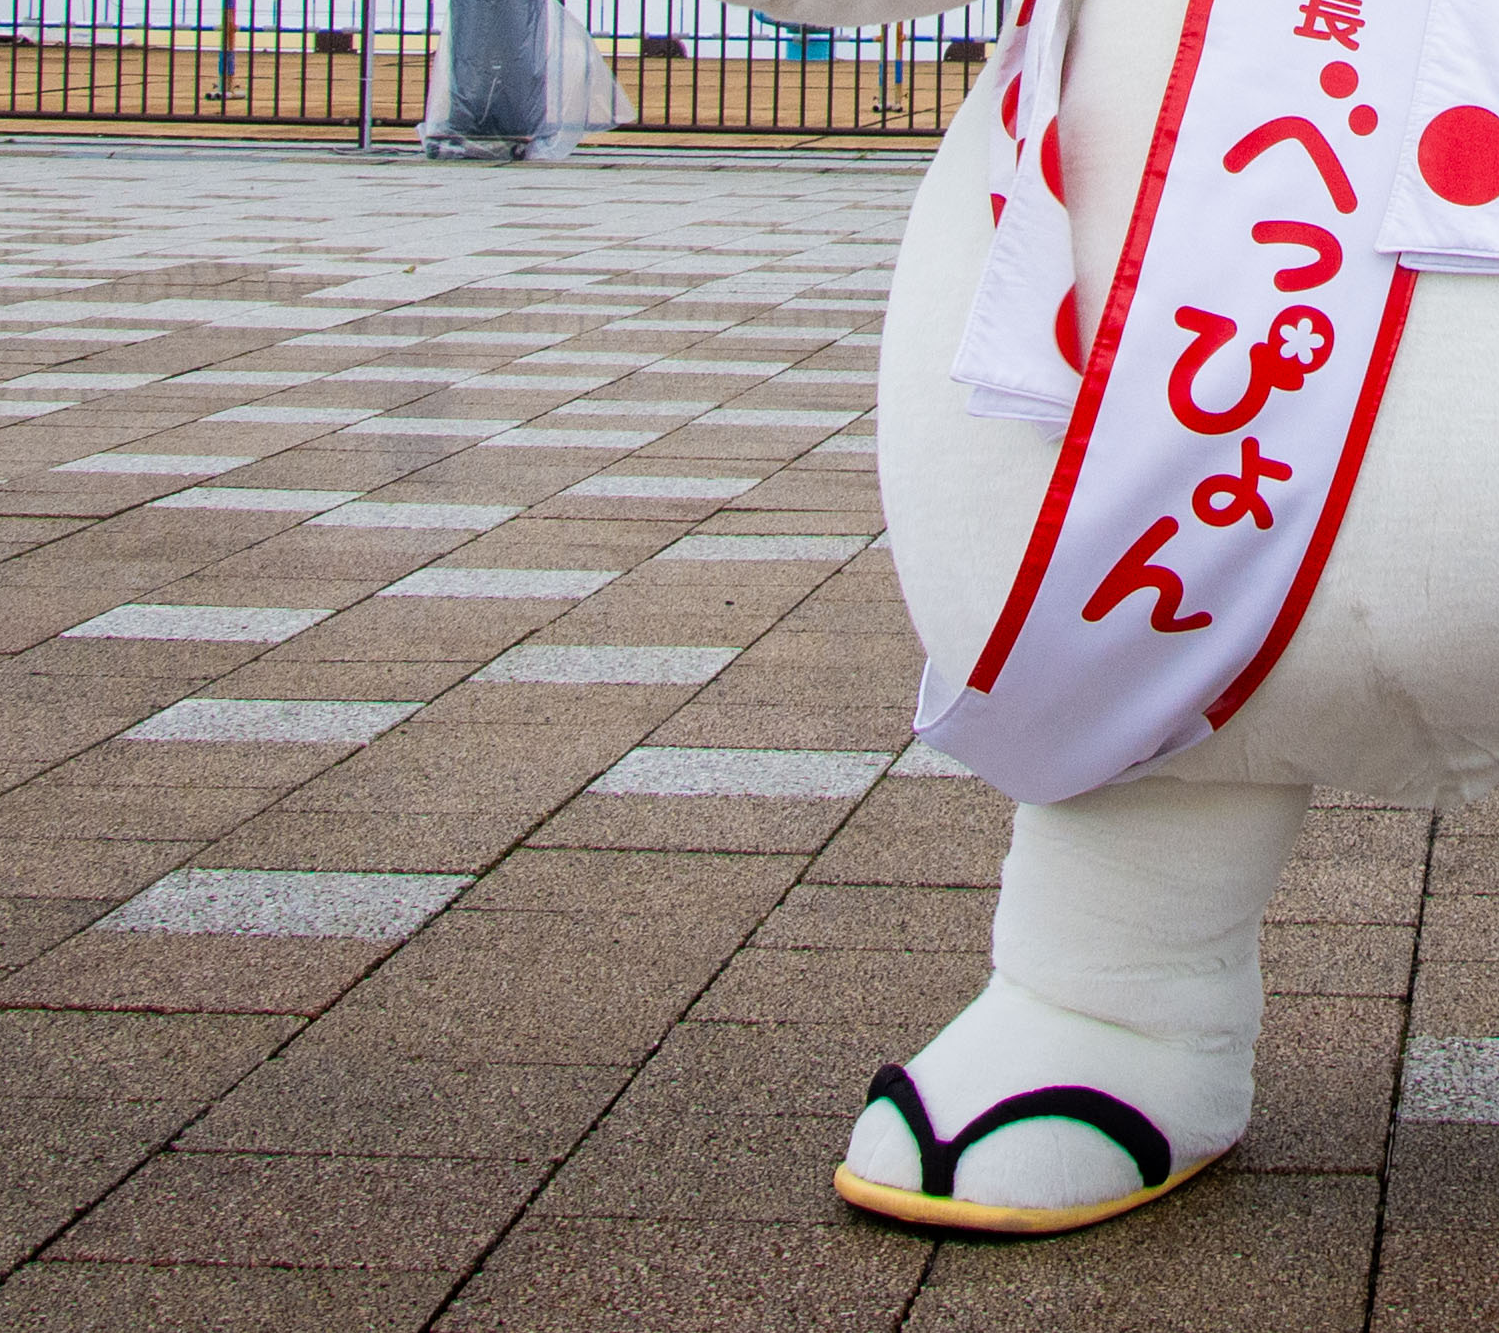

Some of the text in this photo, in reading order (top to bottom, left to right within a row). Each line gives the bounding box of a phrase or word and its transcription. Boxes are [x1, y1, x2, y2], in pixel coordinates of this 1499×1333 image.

[1081, 60, 1379, 633] べっぴょん
